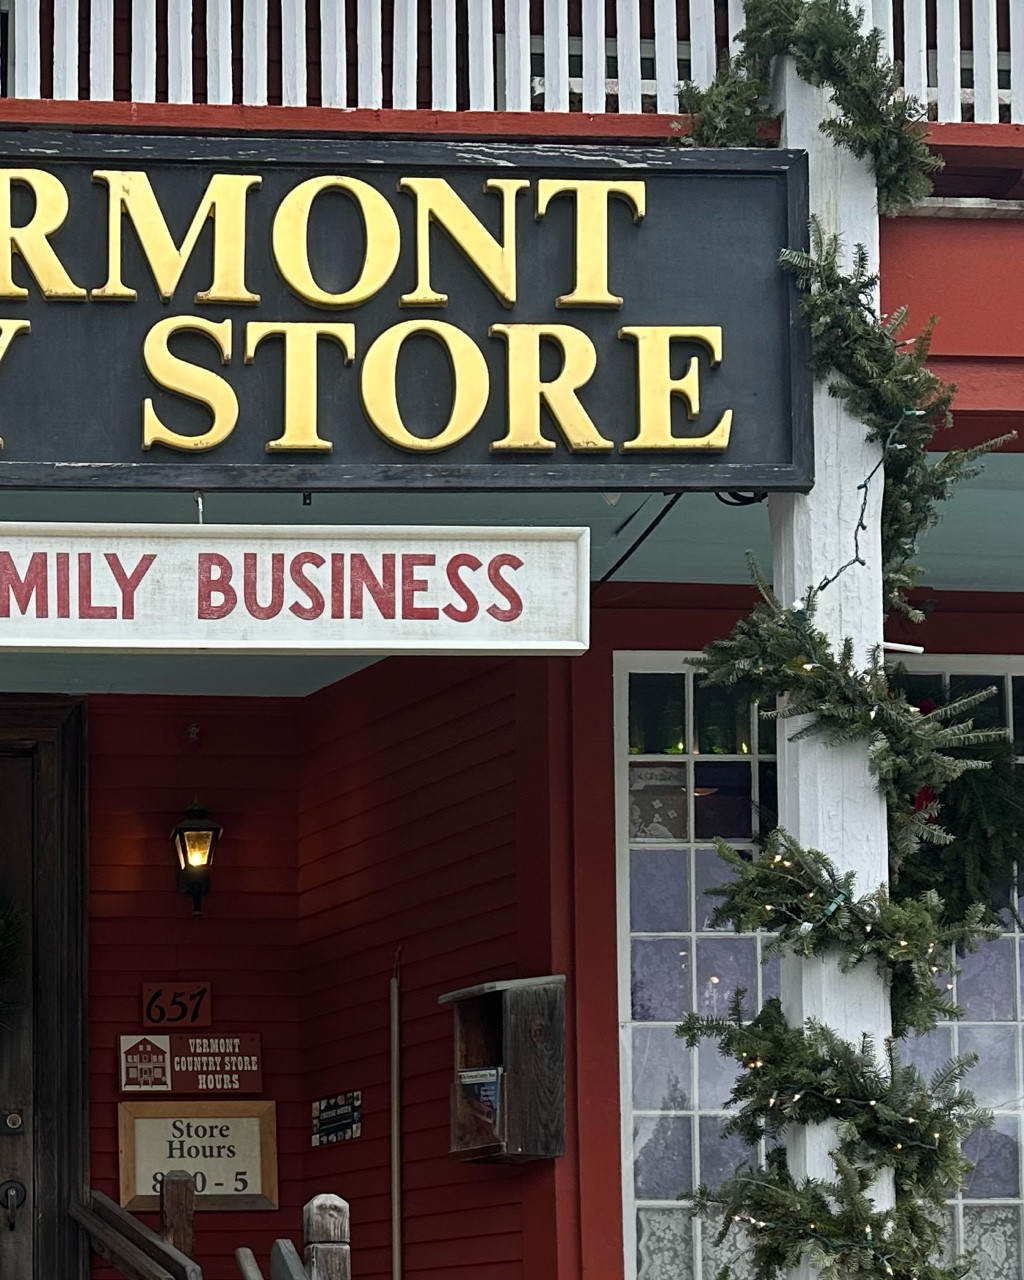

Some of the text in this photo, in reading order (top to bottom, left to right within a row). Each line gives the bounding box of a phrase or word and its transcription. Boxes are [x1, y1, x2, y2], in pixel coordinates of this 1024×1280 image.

[142, 316, 733, 453] STORE
[198, 550, 524, 623] BUSINESS
[146, 987, 208, 1023] 657
[189, 1038, 240, 1053] VERMONT
[174, 1056, 258, 1071] COUNTRY STORE
[198, 1074, 240, 1089] HOURS
[171, 1119, 230, 1139] Store
[166, 1139, 236, 1159] Hours
[233, 1171, 249, 1193] 5
